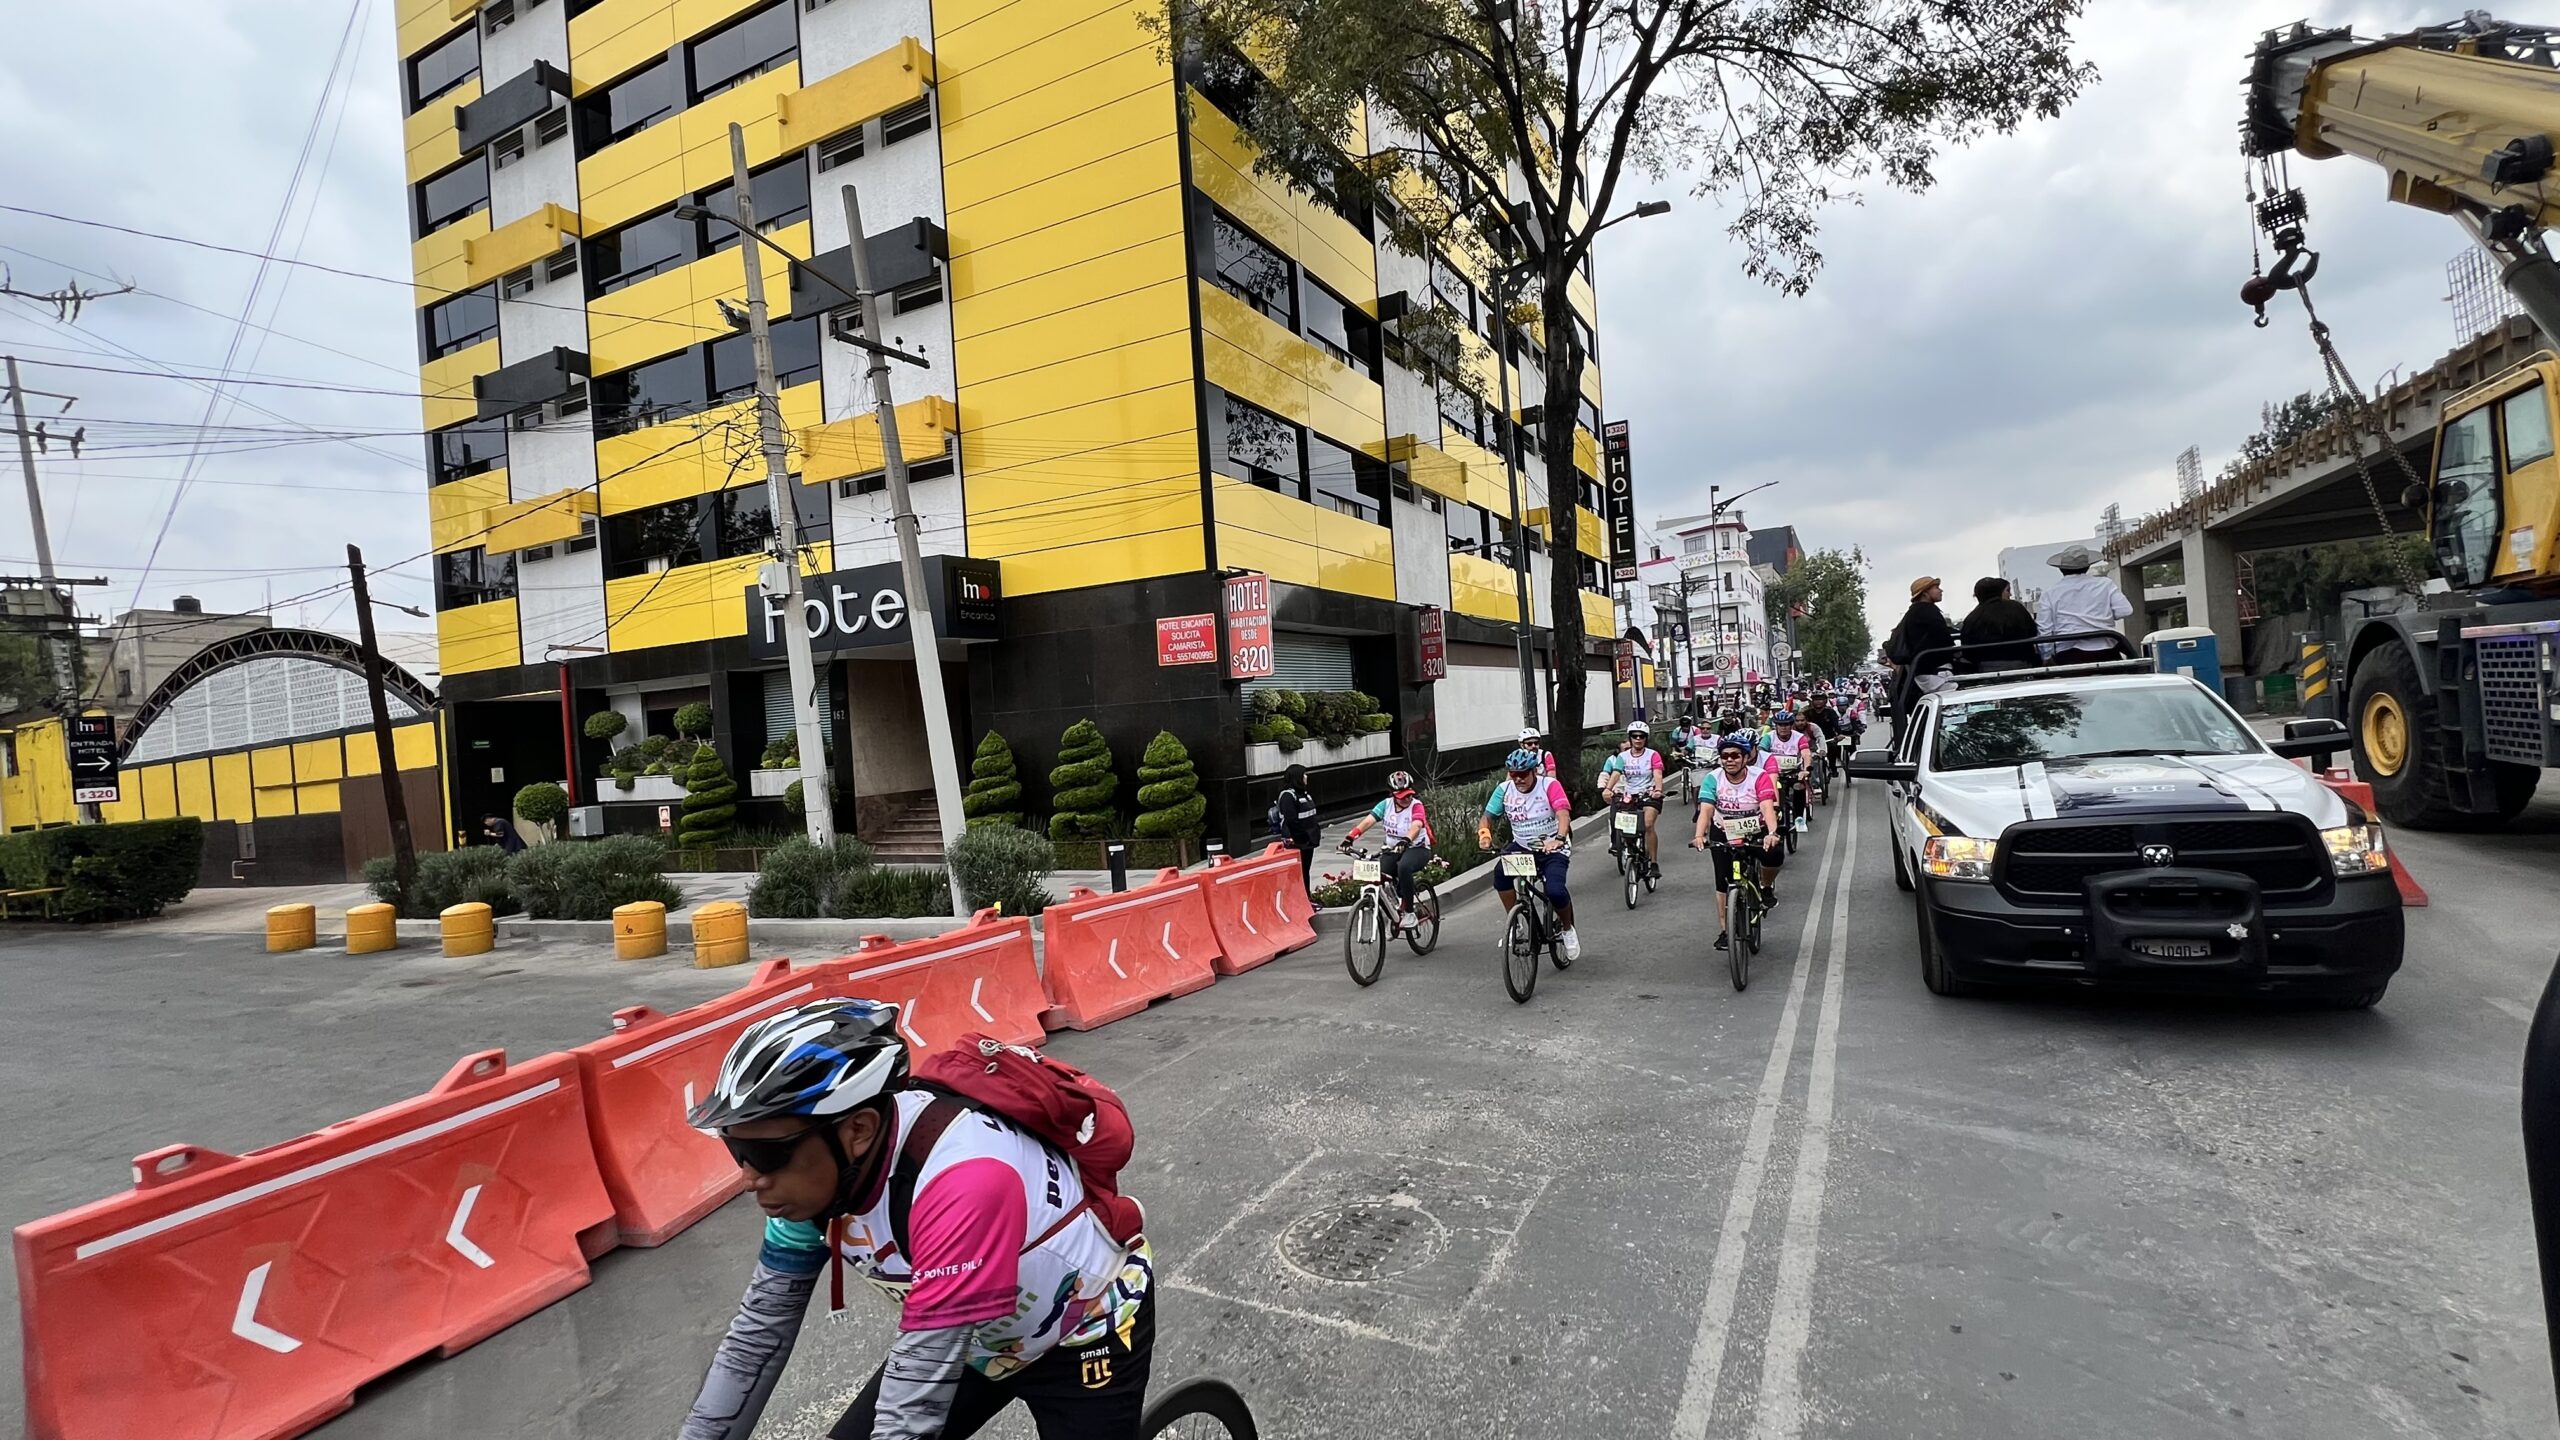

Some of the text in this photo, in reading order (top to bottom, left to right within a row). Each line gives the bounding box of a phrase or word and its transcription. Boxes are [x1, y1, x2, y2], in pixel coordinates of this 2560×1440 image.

[1611, 455, 1631, 554] HOTEL
[1228, 580, 1267, 613] HOTEL
[1159, 617, 1213, 631] HOTEL ENCANTO
[1230, 615, 1267, 628] HABITACION
[1420, 612, 1441, 634] HOTEL
[1171, 630, 1201, 641] SOLICITA
[1240, 628, 1258, 640] DESDE
[1167, 641, 1206, 651] CAMARISTA
[1232, 645, 1269, 673] $320
[1423, 657, 1444, 677] $320
[70, 740, 115, 748] ENTRADA
[1737, 818, 1758, 830] 1452
[1515, 856, 1533, 866] 1085
[1362, 863, 1379, 873] 1084
[923, 1264, 959, 1280] PONTE
[1080, 1345, 1111, 1360] smart
